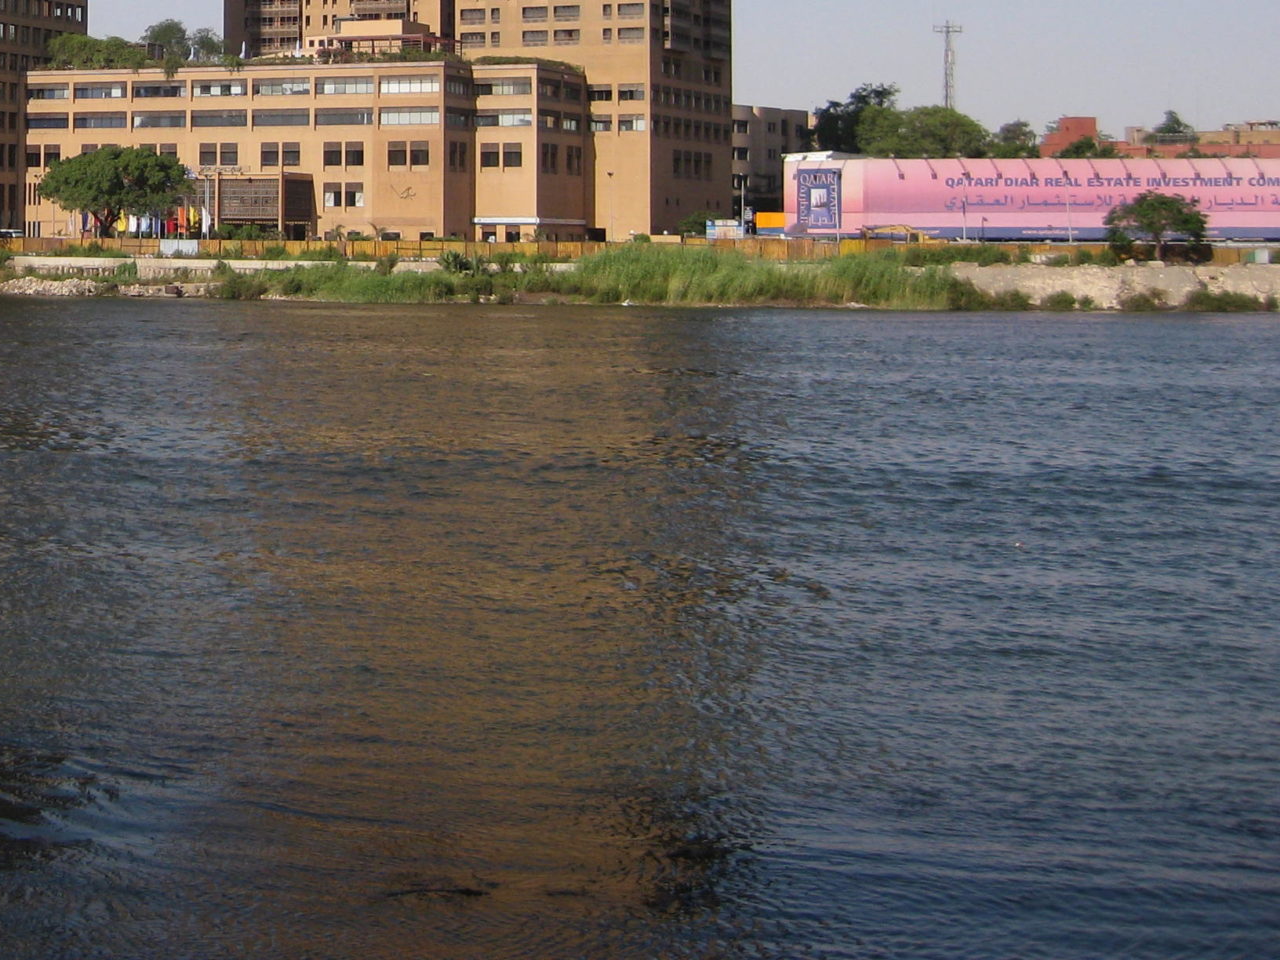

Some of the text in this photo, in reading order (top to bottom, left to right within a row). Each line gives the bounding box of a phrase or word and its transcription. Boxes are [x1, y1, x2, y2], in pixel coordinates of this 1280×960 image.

[800, 173, 834, 187] QATAR
[945, 176, 999, 187] QATARI
[1004, 177, 1040, 187] DIAR
[1044, 177, 1082, 187] REAL
[1087, 177, 1142, 187] ESTATE
[1147, 177, 1242, 187] INVESTMENT
